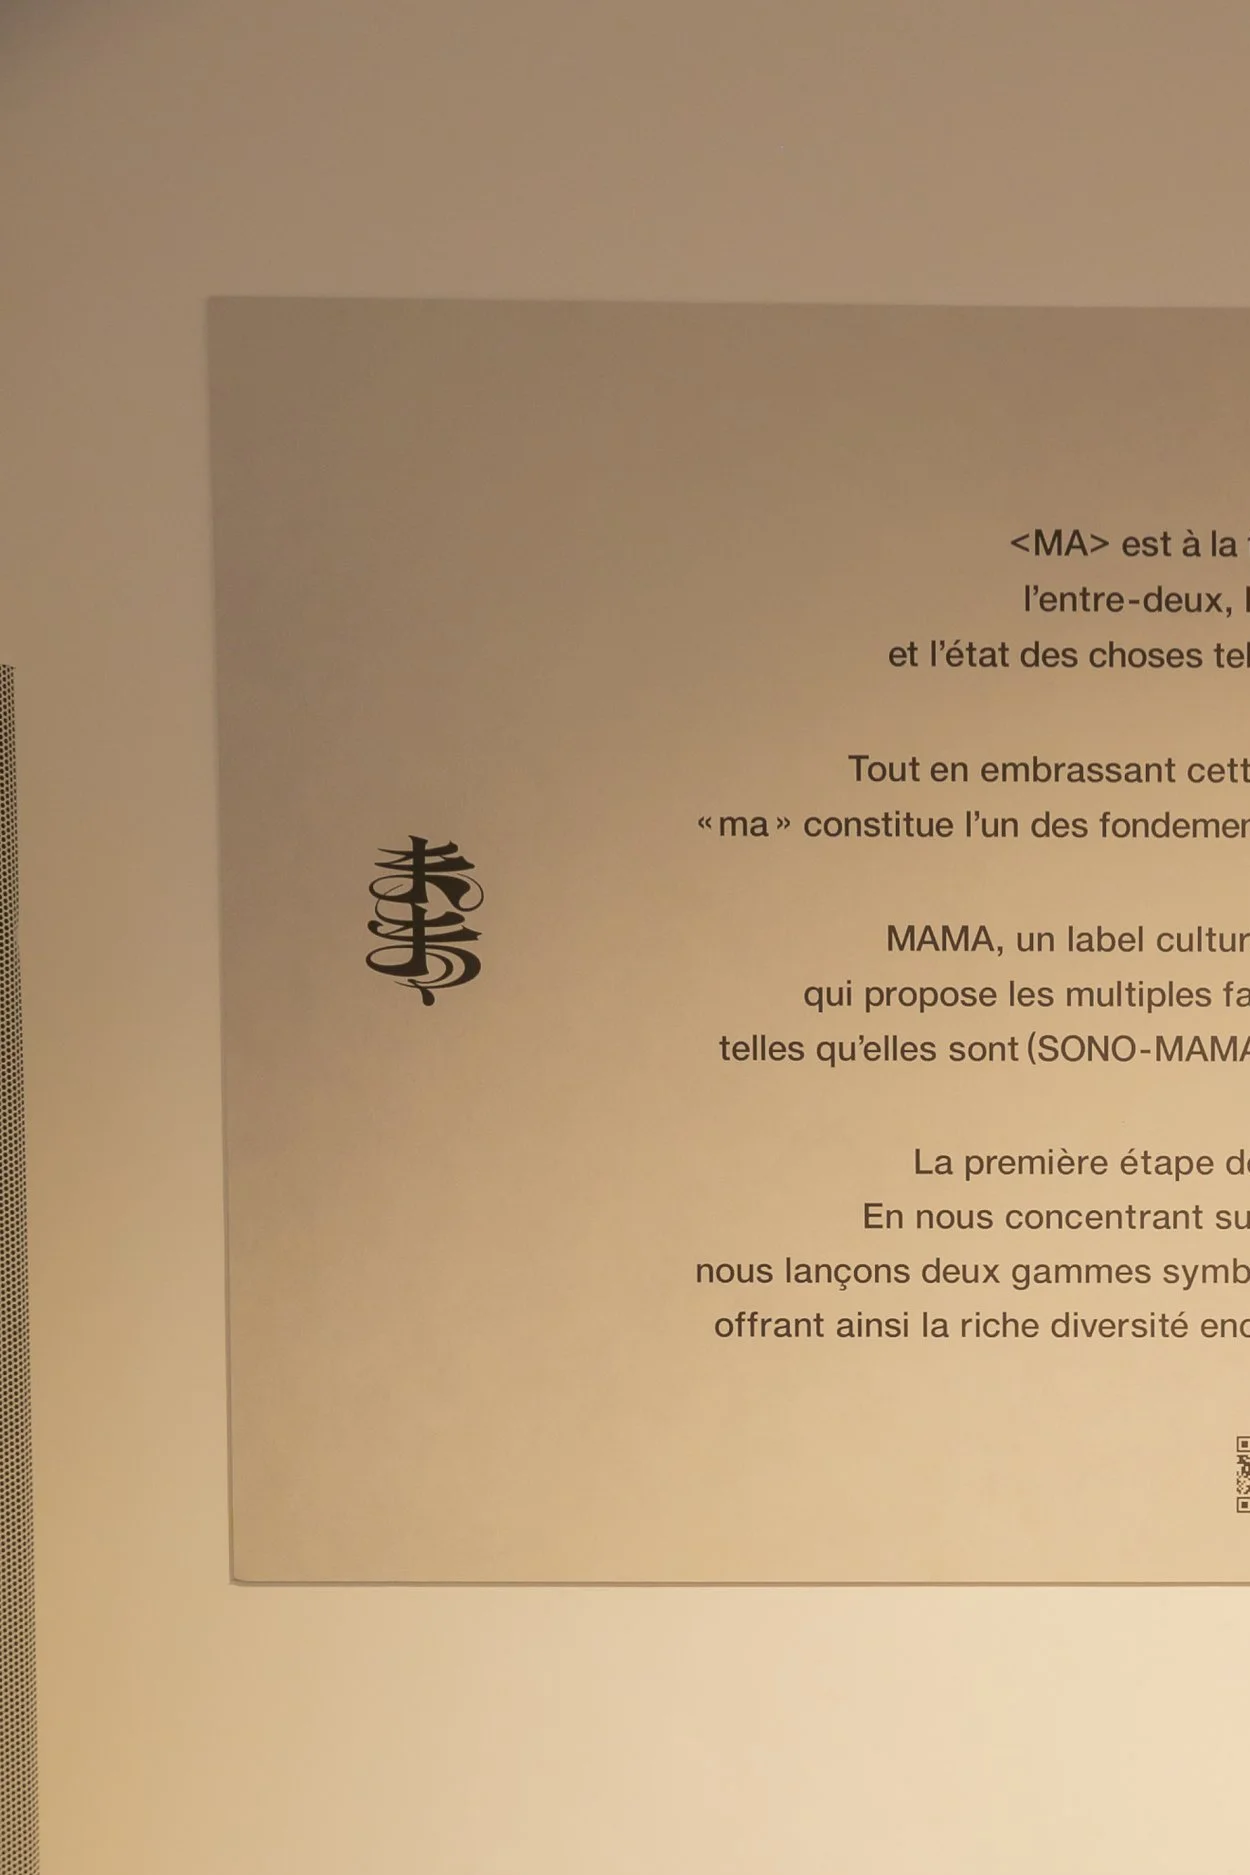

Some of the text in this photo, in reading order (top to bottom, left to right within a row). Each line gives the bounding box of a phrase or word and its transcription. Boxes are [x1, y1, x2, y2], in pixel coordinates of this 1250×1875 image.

[1010, 528, 1110, 557] <MA>
[1121, 530, 1173, 558] est
[1181, 528, 1202, 558] à
[1211, 529, 1239, 558] la
[1024, 584, 1233, 619] l'entre-deux,
[888, 640, 919, 668] et
[930, 638, 1010, 669] l'état
[1019, 639, 1079, 669] des
[1088, 640, 1204, 669] choses
[847, 754, 921, 783] Tout
[929, 761, 969, 783] en
[980, 755, 1177, 784] embrassant
[803, 809, 954, 839] constitue
[965, 809, 1019, 839] l'un
[1030, 810, 1089, 839] des
[887, 924, 1004, 958] MAMA,
[1016, 931, 1055, 953] un
[1068, 924, 1144, 953] label
[803, 979, 852, 1014] qui
[864, 986, 998, 1014] propose
[1009, 979, 1055, 1008] les
[1066, 980, 1213, 1015] multiples
[718, 1033, 805, 1062] telles
[816, 1034, 937, 1069] qu'elles
[914, 1148, 954, 1176] La
[965, 1147, 1109, 1182] première
[1119, 1147, 1215, 1182] étape
[863, 1202, 904, 1230] En
[916, 1209, 994, 1230] nous
[1005, 1204, 1204, 1231] concentrant
[696, 1262, 774, 1284] nous
[785, 1256, 911, 1292] lançons
[921, 1256, 1001, 1284] deux
[1011, 1263, 1152, 1291] gammes
[714, 1310, 825, 1338] offrant
[836, 1310, 909, 1339] ainsi
[922, 1311, 950, 1339] la
[961, 1311, 1040, 1339] riche
[1050, 1310, 1189, 1339] diversité
